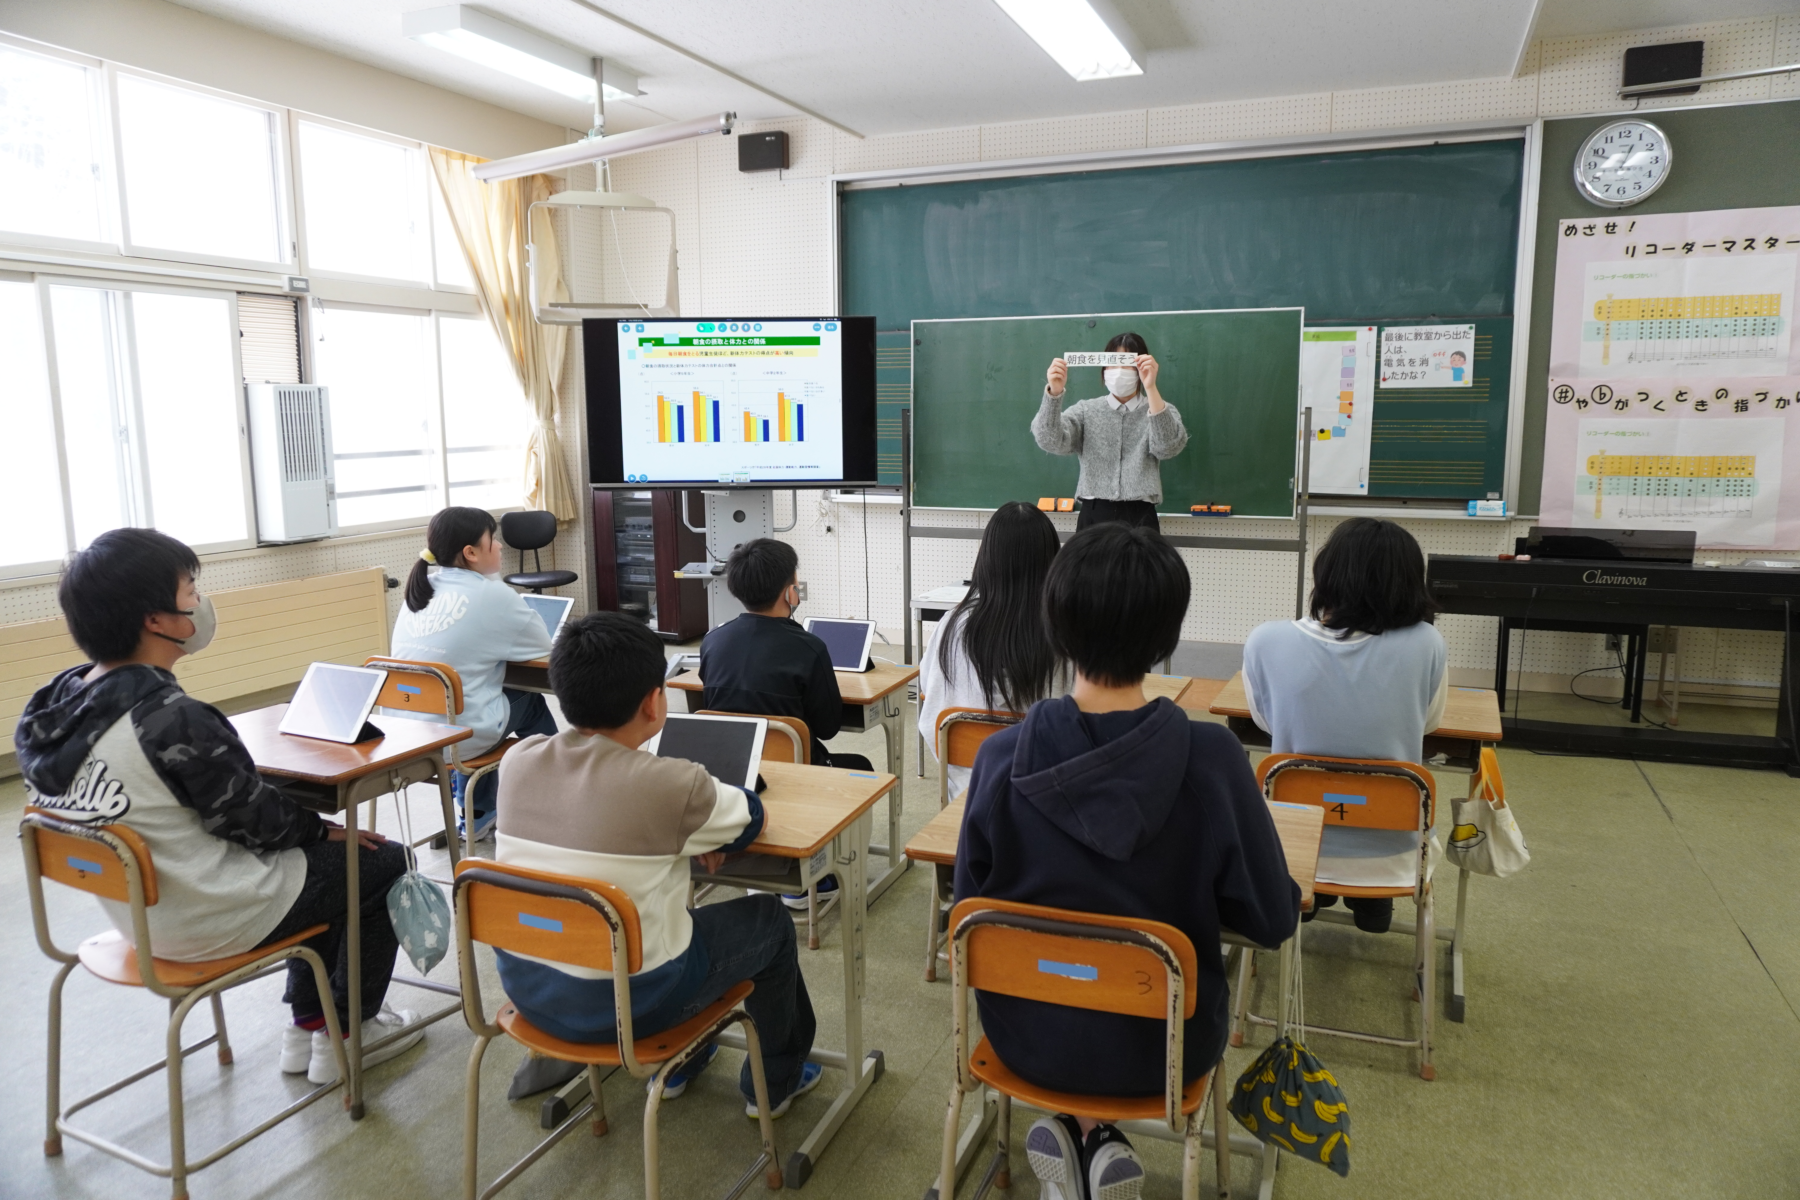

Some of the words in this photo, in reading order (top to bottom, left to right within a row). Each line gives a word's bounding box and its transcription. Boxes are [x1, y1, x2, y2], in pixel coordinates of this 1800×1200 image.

[1618, 130, 1632, 139] 12
[1639, 133, 1643, 141] 1
[1604, 135, 1614, 144] 11
[1645, 142, 1655, 151] 2
[1593, 147, 1605, 156] 10
[1649, 156, 1659, 164] 3
[1588, 161, 1597, 169] 9
[1642, 169, 1652, 178] 4
[1603, 183, 1612, 192] 7
[1633, 181, 1642, 190] 5
[1617, 186, 1626, 195] 6
[1625, 236, 1800, 257] リコーダーマスター
[1384, 330, 1471, 342] 最後に教室から出た
[1384, 345, 1407, 354] 人は、
[1384, 357, 1429, 367] 電気を消
[1383, 371, 1427, 380] したかな？
[1582, 569, 1648, 586] Clavinova
[403, 693, 411, 703] 3
[1330, 802, 1348, 821] 4
[1135, 970, 1153, 996] 3
